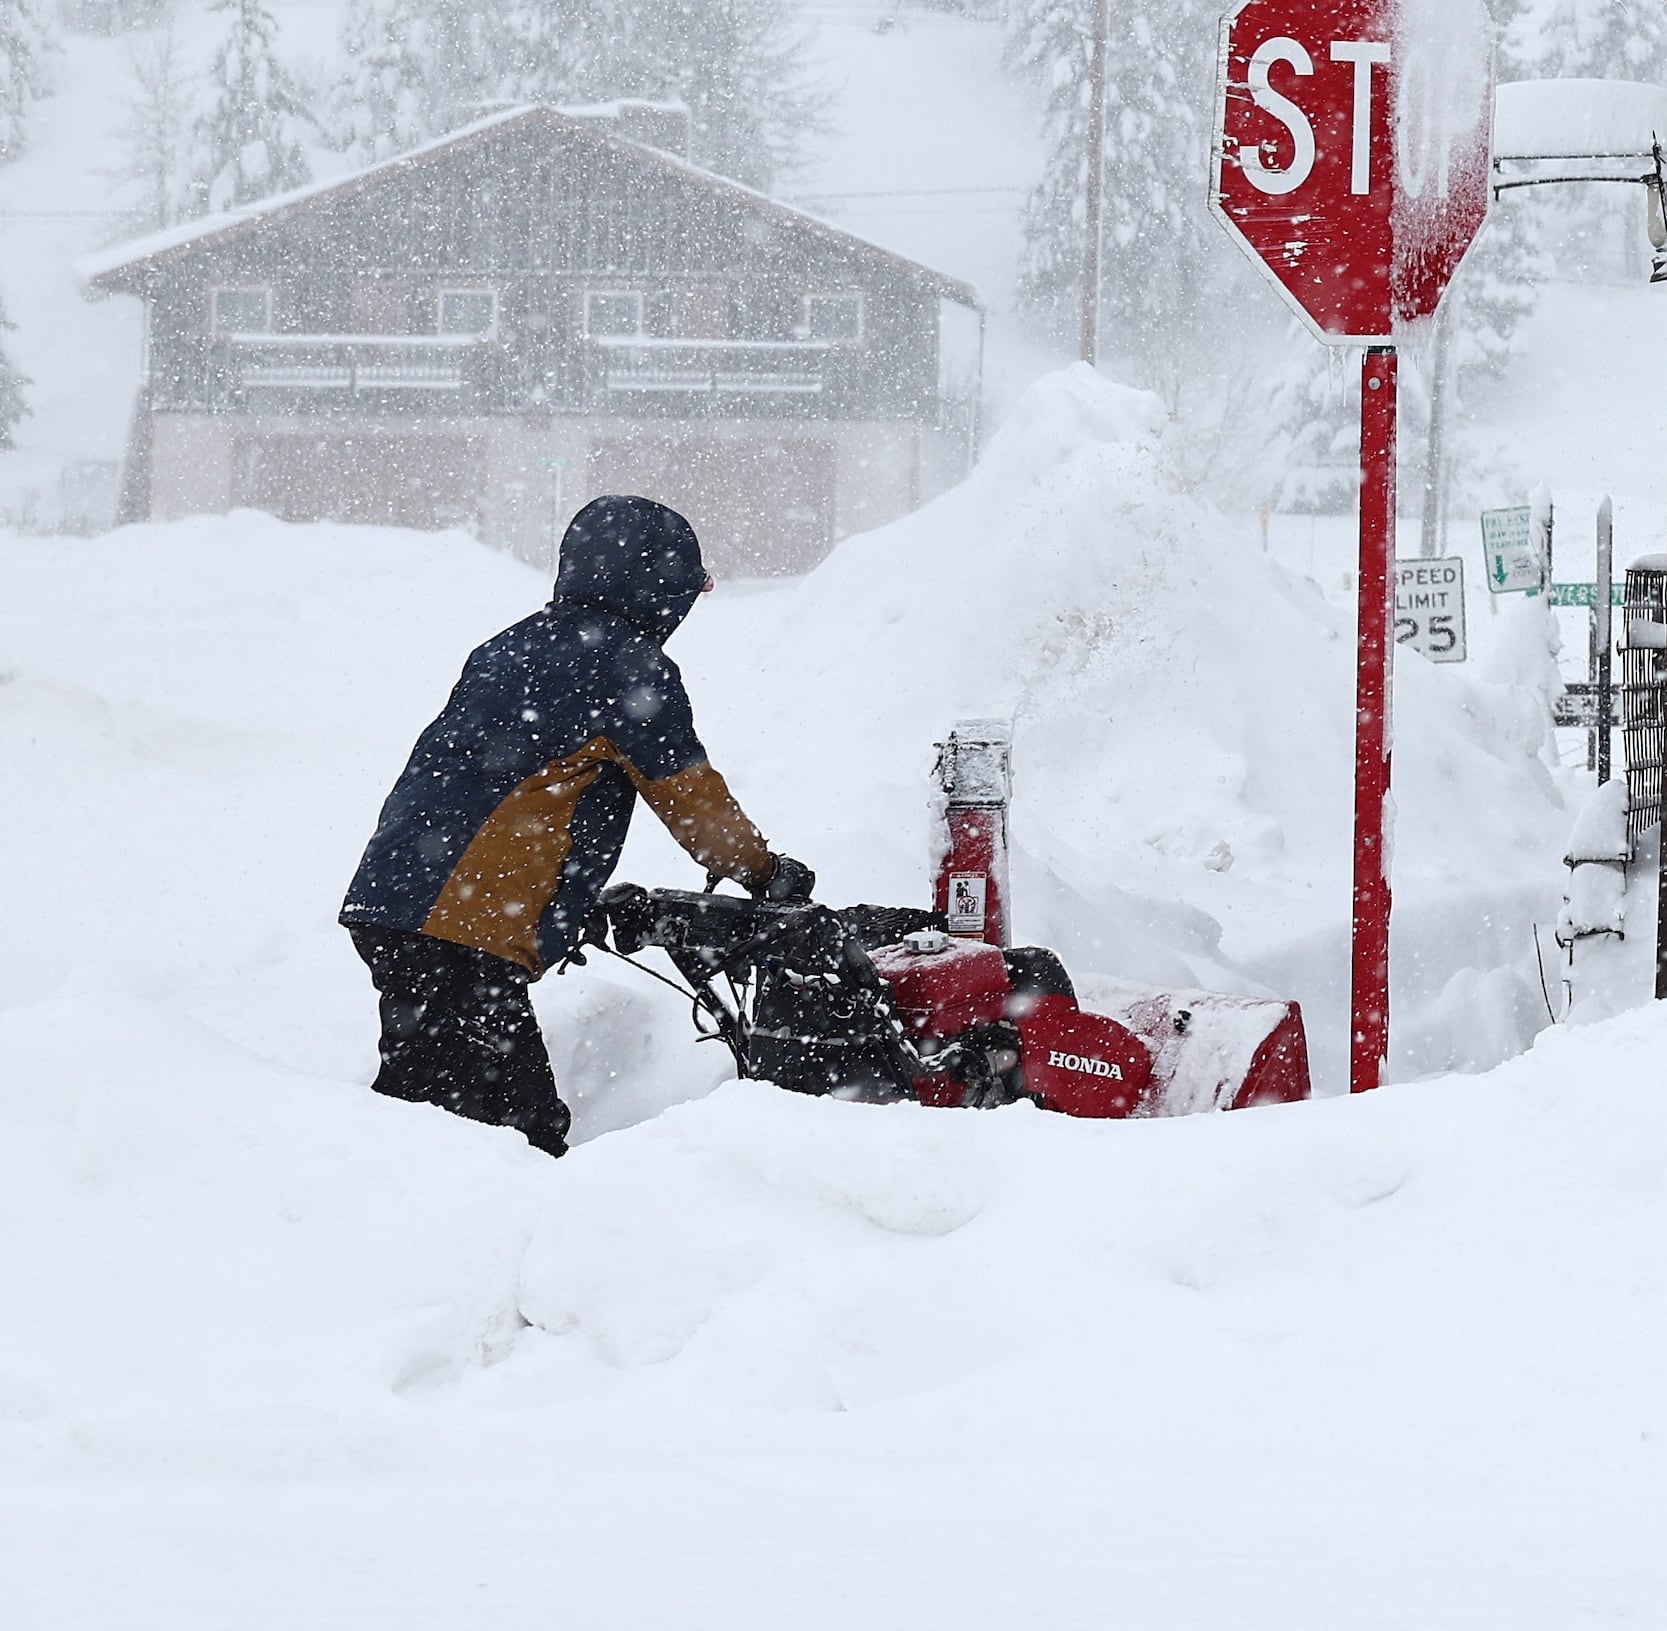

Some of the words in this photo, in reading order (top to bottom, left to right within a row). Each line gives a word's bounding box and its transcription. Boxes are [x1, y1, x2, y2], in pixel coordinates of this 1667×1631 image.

[1396, 591, 1448, 609] LIMIT
[1393, 615, 1456, 652] 25
[1047, 1050, 1123, 1081] HONDA
